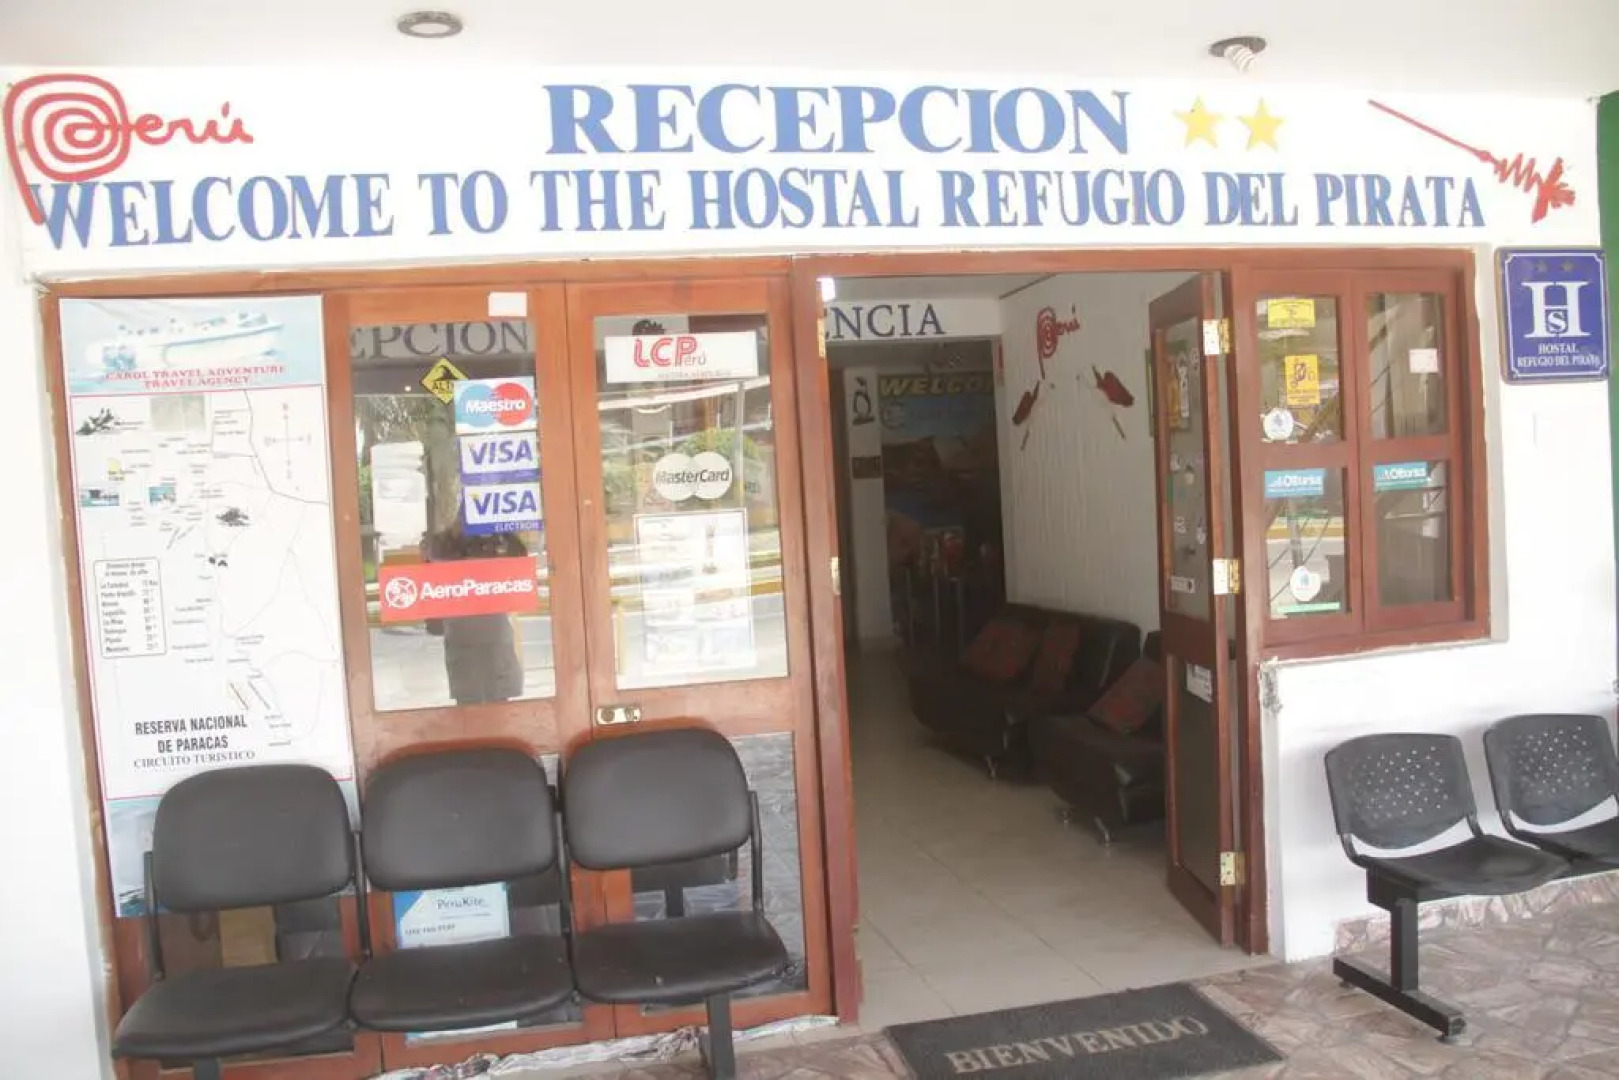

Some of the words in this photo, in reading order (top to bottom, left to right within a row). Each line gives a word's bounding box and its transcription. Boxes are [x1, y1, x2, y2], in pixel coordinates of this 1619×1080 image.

[543, 83, 1132, 155] RECEPCION
[30, 173, 394, 250] WELCOME
[419, 169, 509, 236] TO
[530, 170, 666, 232] THE
[687, 167, 920, 230] HOSTAL
[937, 168, 1185, 229] REFUGIO
[1203, 171, 1299, 227] DEL
[1314, 173, 1486, 228] PIRATA
[824, 303, 945, 339] NCIA
[1538, 343, 1577, 354] HOSTAL
[1518, 356, 1553, 367] REFUGIO
[1555, 355, 1571, 366] DEL
[105, 371, 148, 382] CAROL
[153, 368, 201, 379] TRAVEL
[144, 376, 200, 388] TRAVEL
[200, 374, 251, 386] AGENCY
[877, 373, 993, 397] WELCO
[465, 398, 526, 414] Maestro
[469, 439, 533, 466] VISA
[655, 468, 730, 485] MasterCard
[472, 489, 537, 517] VISA
[494, 521, 541, 532] ELECTRON
[420, 577, 534, 601] AeroParacas
[135, 717, 187, 735] RESERVA
[190, 713, 248, 731] NACIONAL
[157, 739, 173, 753] DE
[176, 735, 229, 752] PARACAS
[133, 753, 191, 768] CIRCUITO
[195, 750, 256, 764] TURISTICO
[944, 1014, 1209, 1074] BIENVENIDO
